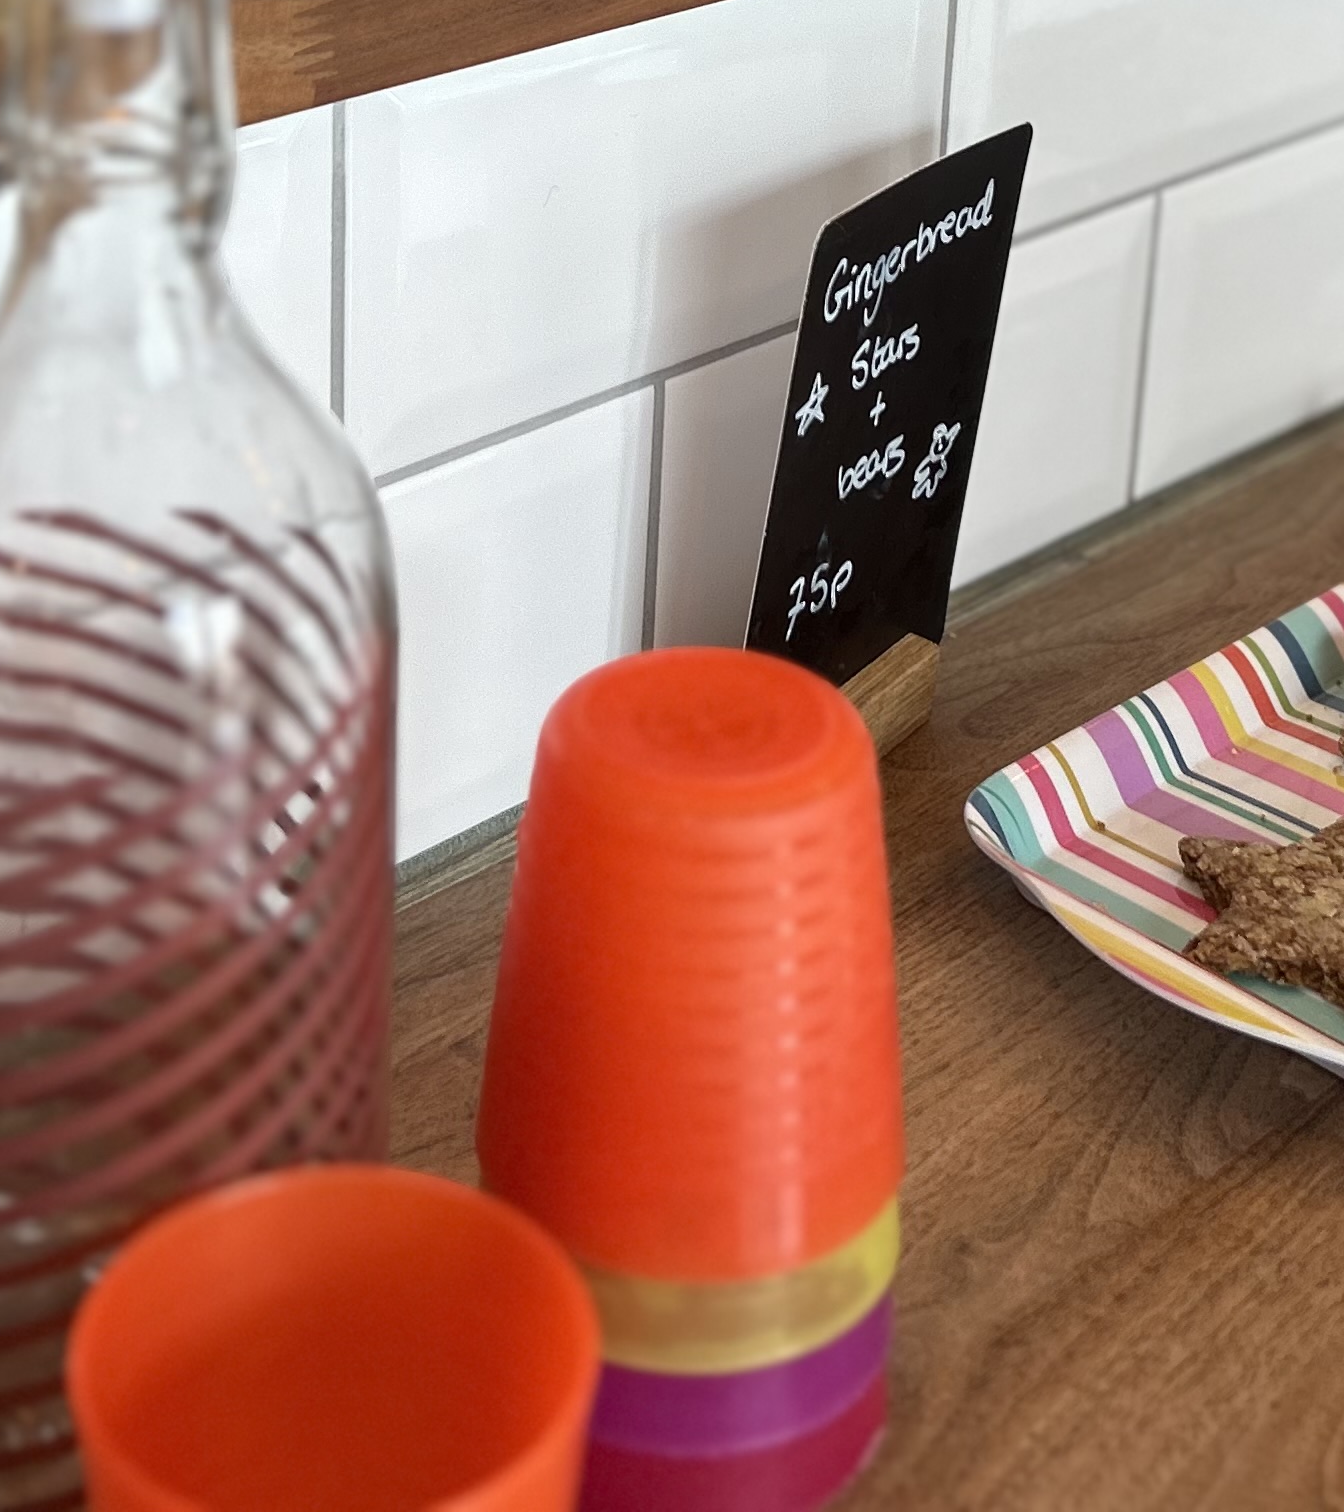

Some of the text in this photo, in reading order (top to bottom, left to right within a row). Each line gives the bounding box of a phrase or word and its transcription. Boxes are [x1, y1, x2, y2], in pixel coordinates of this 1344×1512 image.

[823, 176, 996, 328] Gingerbread
[850, 322, 921, 390] Stars
[837, 433, 906, 501] bears
